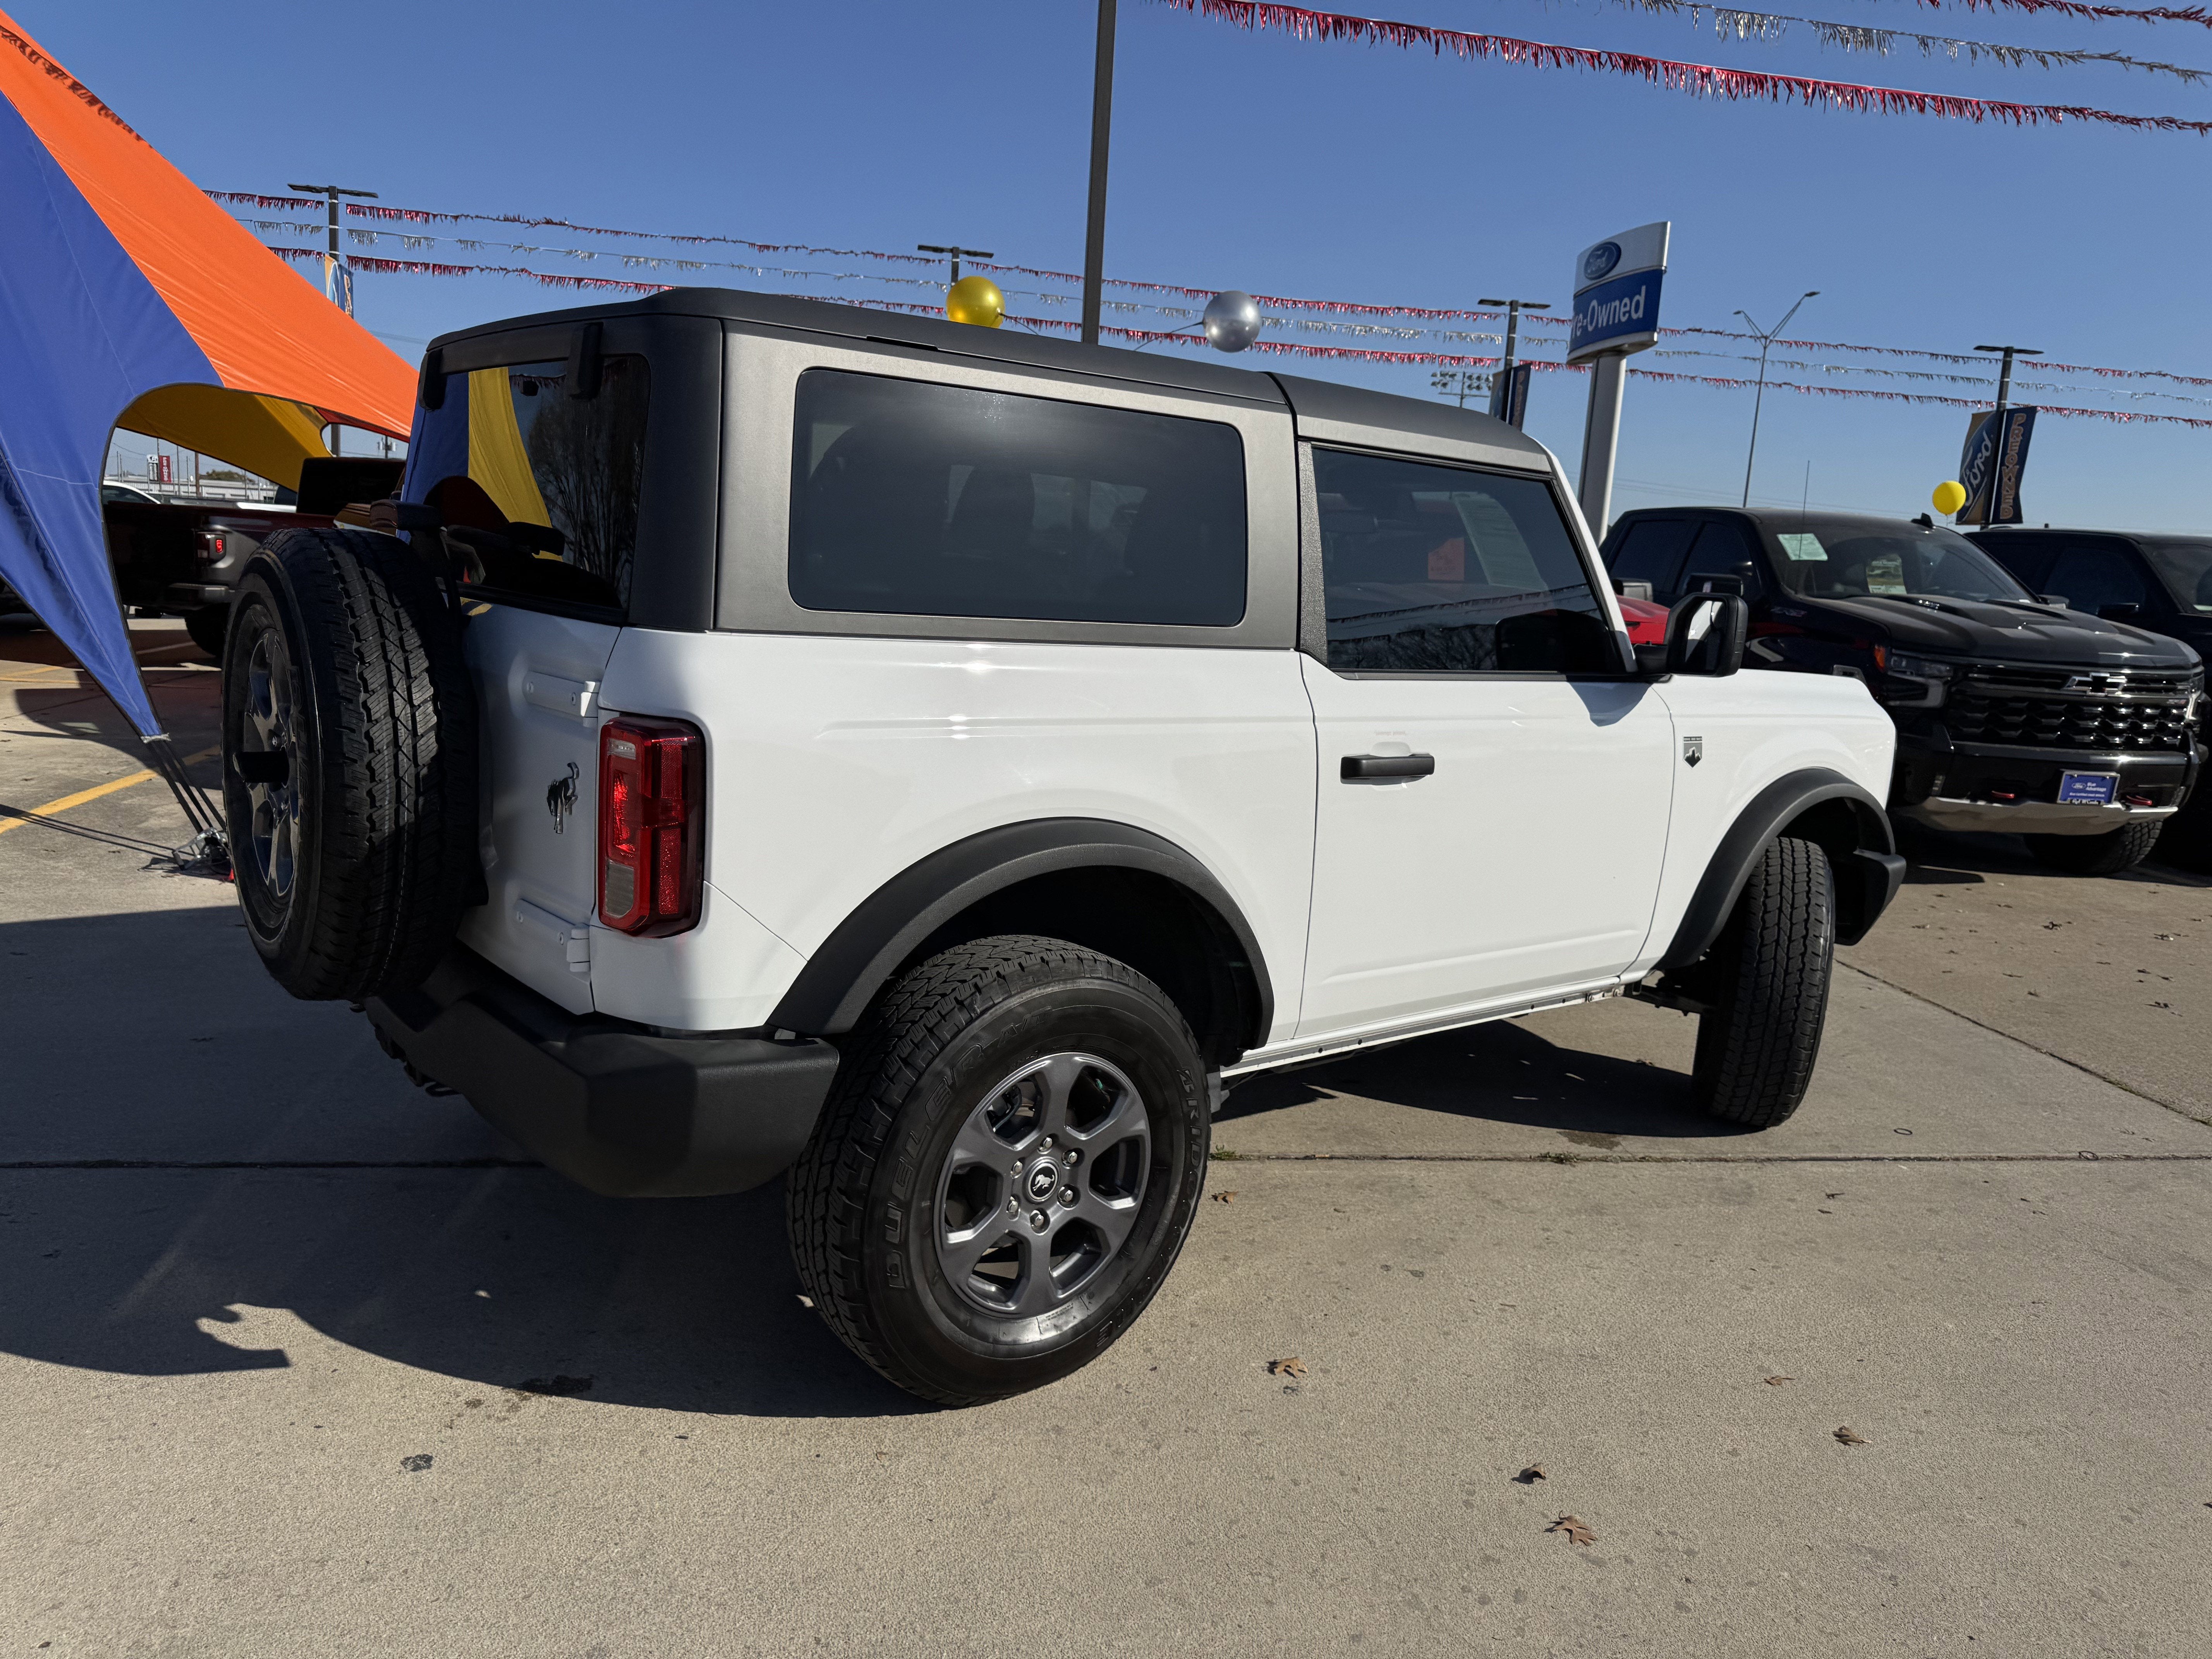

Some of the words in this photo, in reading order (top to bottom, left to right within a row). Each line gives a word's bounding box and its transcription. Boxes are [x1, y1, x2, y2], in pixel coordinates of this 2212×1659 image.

[1571, 285, 1646, 339] re-Owned
[1963, 430, 1991, 506] Ford
[885, 1042, 985, 1288] DUELER
[1096, 1068, 1204, 1349] BRIDGNE
